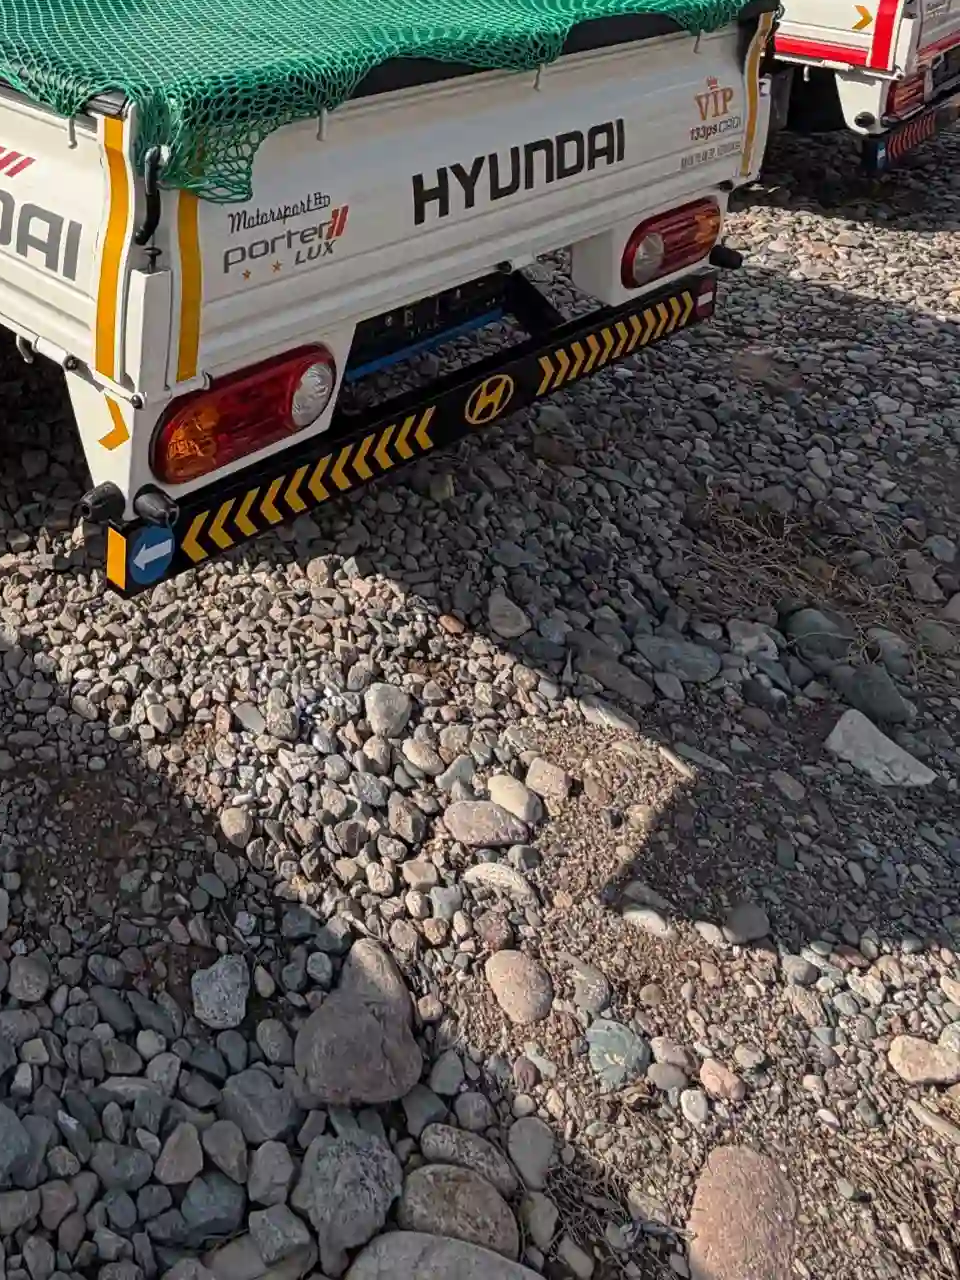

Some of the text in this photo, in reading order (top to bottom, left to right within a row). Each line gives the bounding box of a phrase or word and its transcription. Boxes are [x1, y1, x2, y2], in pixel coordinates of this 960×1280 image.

[694, 87, 734, 121] VIP
[411, 118, 625, 226] HYUNDAI
[228, 193, 312, 234] Motorsport
[294, 239, 337, 265] LUX
